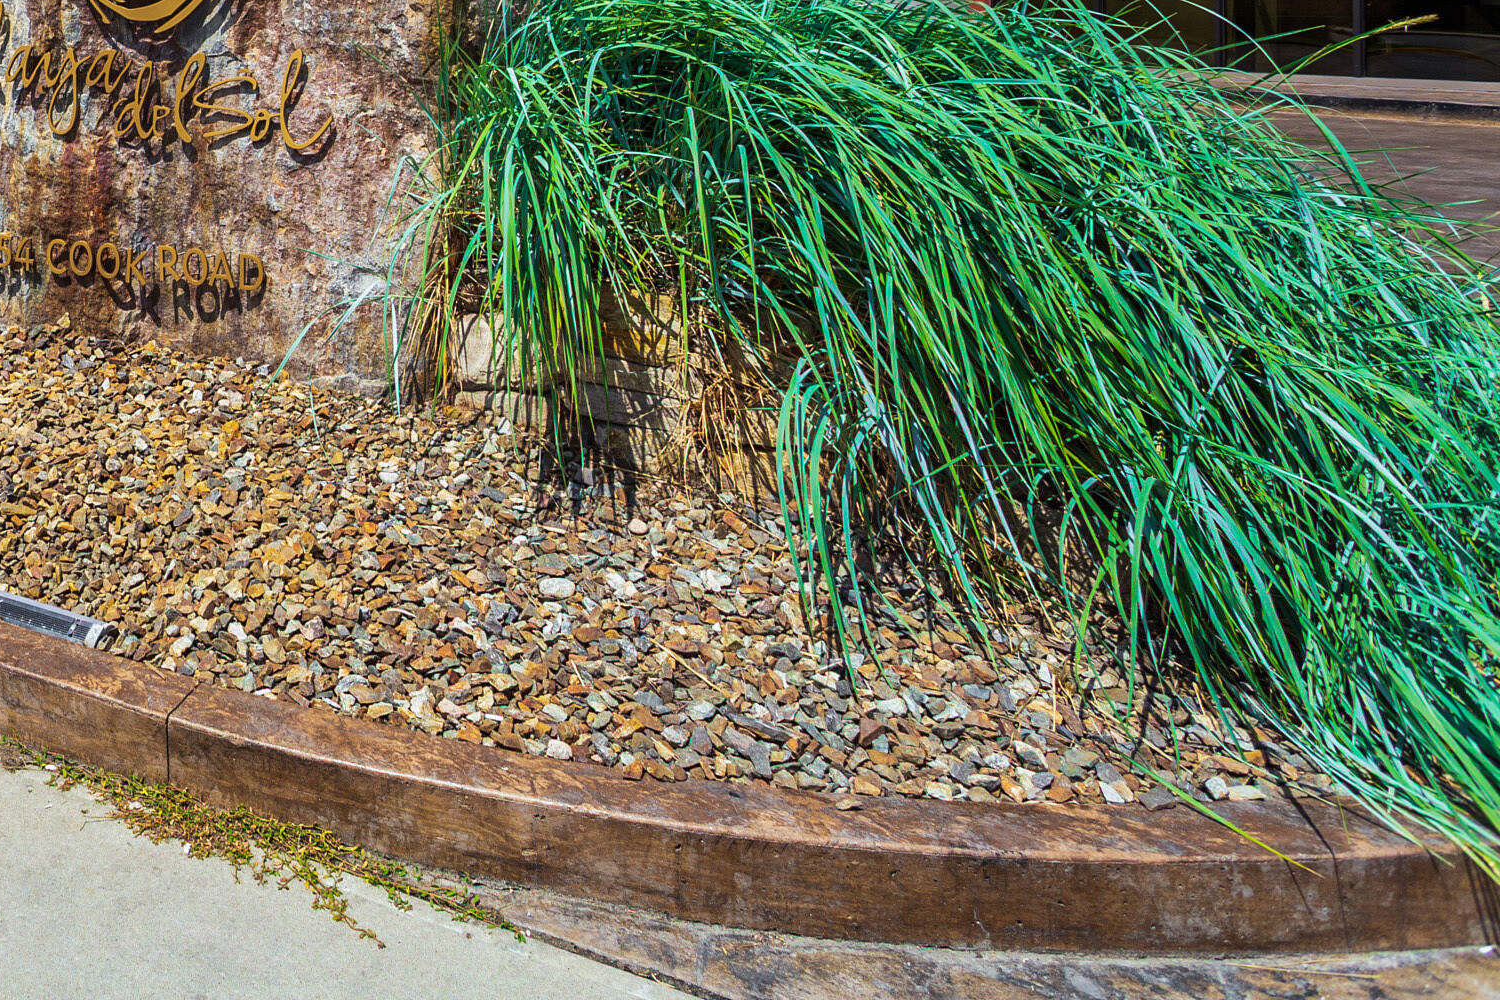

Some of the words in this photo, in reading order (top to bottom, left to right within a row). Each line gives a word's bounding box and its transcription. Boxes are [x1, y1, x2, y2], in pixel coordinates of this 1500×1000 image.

[113, 49, 206, 143] del
[194, 49, 333, 150] Sol
[46, 238, 147, 287] COOK
[158, 244, 265, 291] ROAD
